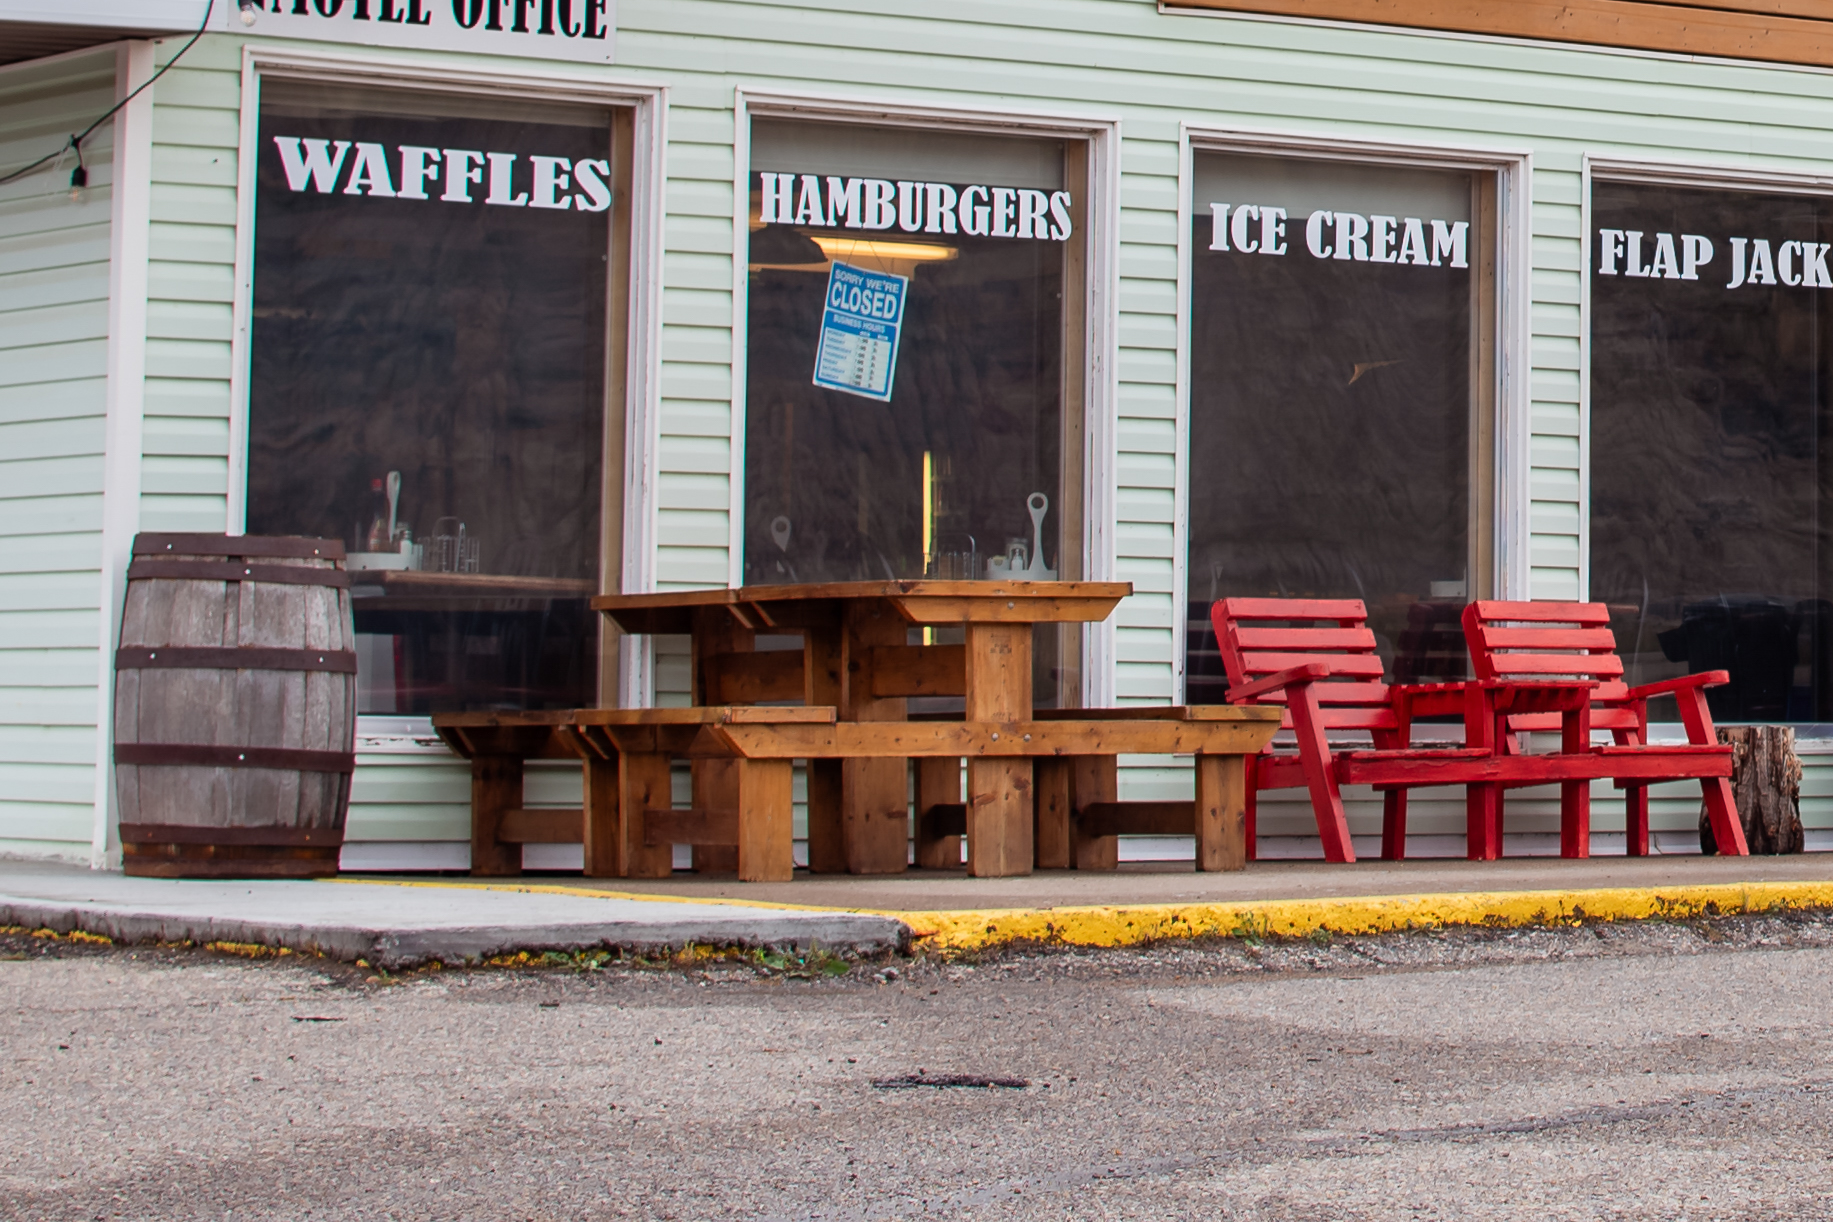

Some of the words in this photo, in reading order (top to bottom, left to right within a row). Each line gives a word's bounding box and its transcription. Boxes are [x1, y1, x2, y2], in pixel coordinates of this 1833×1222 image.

[273, 136, 612, 212] WAFFLES
[758, 171, 1072, 242] HAMBURGERS
[1208, 202, 1287, 256] ICE
[1305, 209, 1470, 268] CREAM
[834, 268, 864, 286] SORRY
[865, 278, 900, 294] WE'RE
[1599, 228, 1714, 280] FLAP
[830, 281, 898, 320] CLOSED
